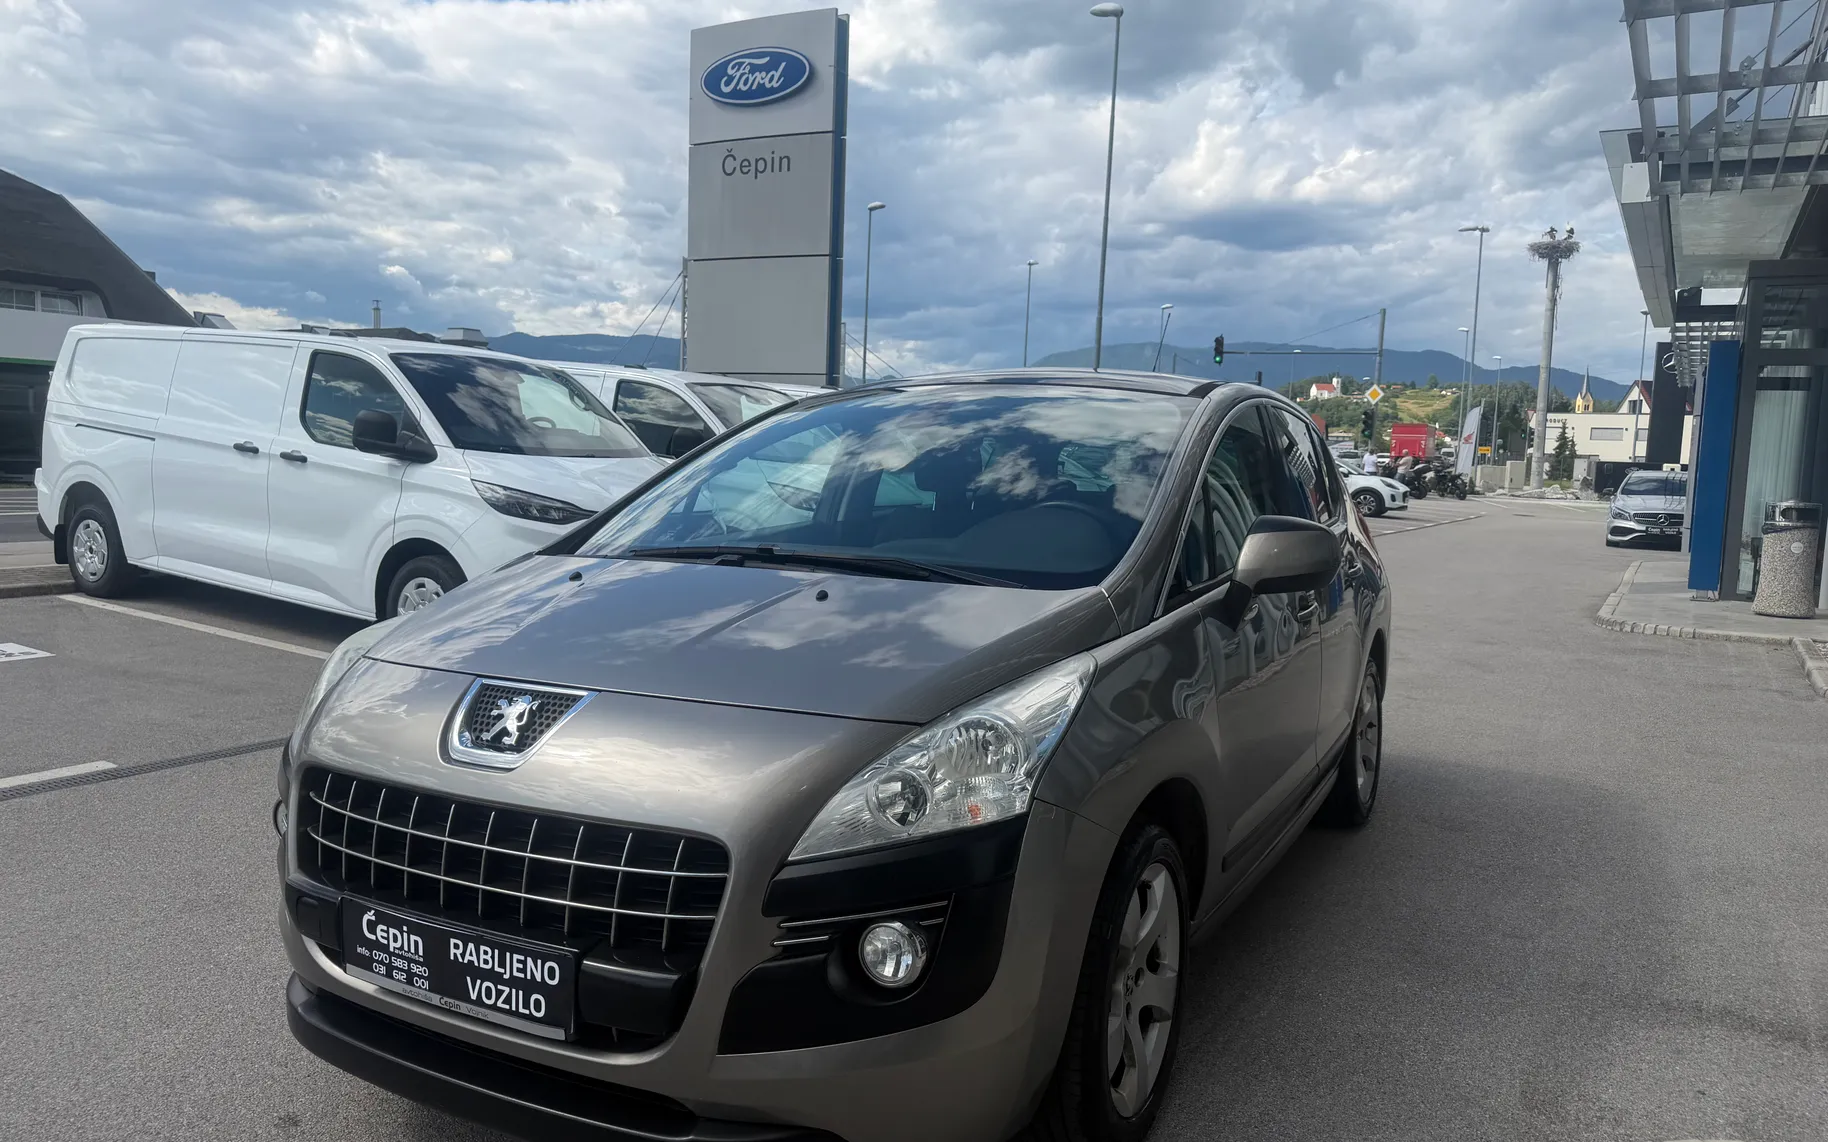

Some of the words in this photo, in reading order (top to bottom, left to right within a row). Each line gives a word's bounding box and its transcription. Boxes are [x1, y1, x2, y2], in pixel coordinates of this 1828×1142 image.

[720, 56, 787, 93] Ford
[721, 148, 791, 179] Čepin
[362, 909, 424, 956] Čepin
[372, 950, 390, 963] 070
[391, 956, 408, 970] 583
[410, 963, 429, 977] 920
[372, 962, 386, 976] 031
[392, 970, 407, 983] 612
[413, 976, 429, 990] 001
[449, 938, 560, 986] RABLJENO
[466, 976, 546, 1018] VOZILO
